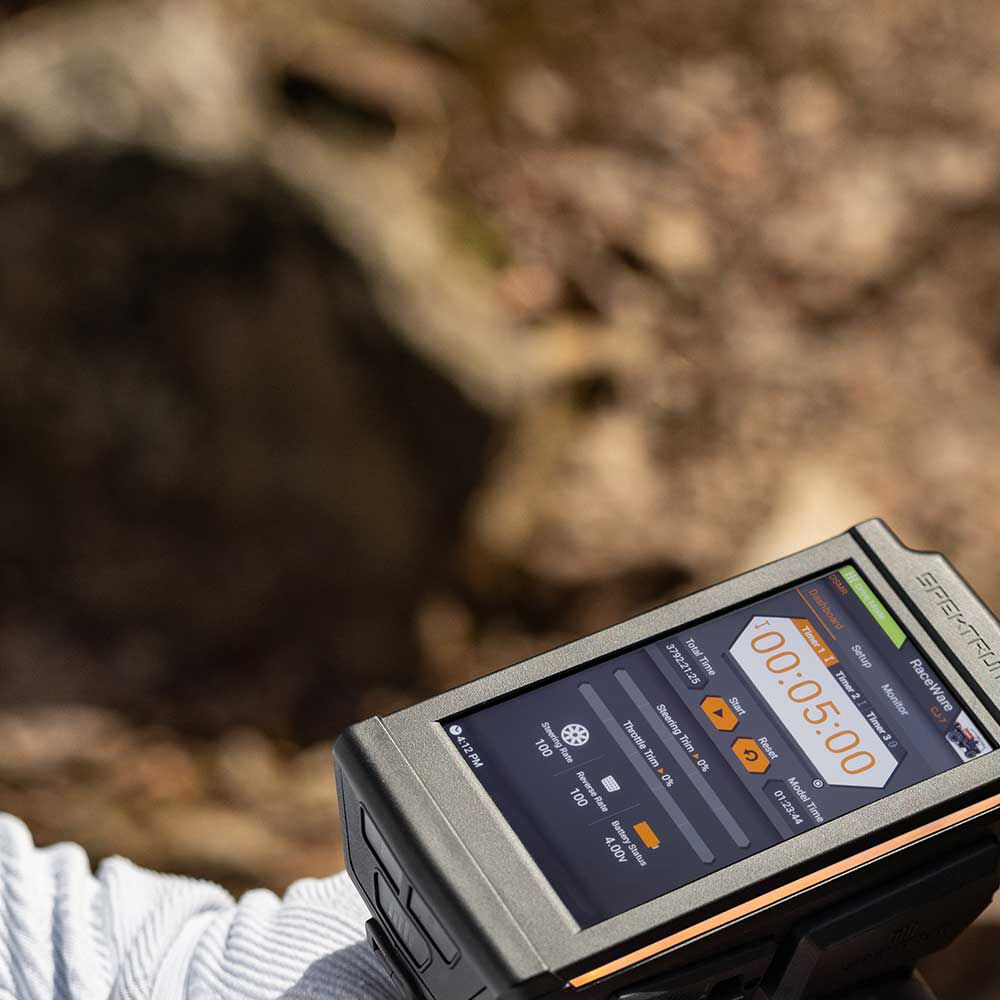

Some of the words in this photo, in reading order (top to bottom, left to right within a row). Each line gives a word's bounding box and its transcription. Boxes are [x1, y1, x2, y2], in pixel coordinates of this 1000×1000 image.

[807, 588, 843, 630] Dashboard
[801, 625, 822, 649] Timer
[666, 643, 701, 685] 3792:21:25
[686, 638, 704, 657] Total
[699, 655, 715, 675] Time
[851, 644, 872, 668] Setup
[834, 670, 857, 694] Timer
[850, 691, 861, 701] 2
[880, 683, 910, 716] Monitor
[910, 658, 952, 711] RaceWare
[728, 697, 747, 717] Start
[751, 631, 875, 774] 00:05:00
[541, 721, 561, 749] Steering
[558, 747, 574, 764] Rate
[656, 703, 682, 735] Steering
[679, 733, 694, 753] Trim
[696, 759, 710, 773] 0%
[865, 711, 888, 735] Timer
[881, 732, 892, 742] 3
[457, 736, 474, 754] 4:12
[468, 751, 484, 769] PM
[535, 738, 553, 757] 100
[623, 719, 647, 750] Throttle
[643, 748, 660, 767] Trim
[661, 773, 675, 787] 0%
[758, 736, 779, 760] Reset
[570, 787, 589, 807] 100
[576, 770, 598, 797] Reverse
[593, 795, 609, 813] Rate
[774, 790, 803, 824] 01:23:44
[787, 776, 807, 803] Model
[807, 801, 825, 822] Time
[605, 836, 628, 863] 4.00v
[611, 820, 631, 845] Battery
[628, 842, 648, 867] Status
